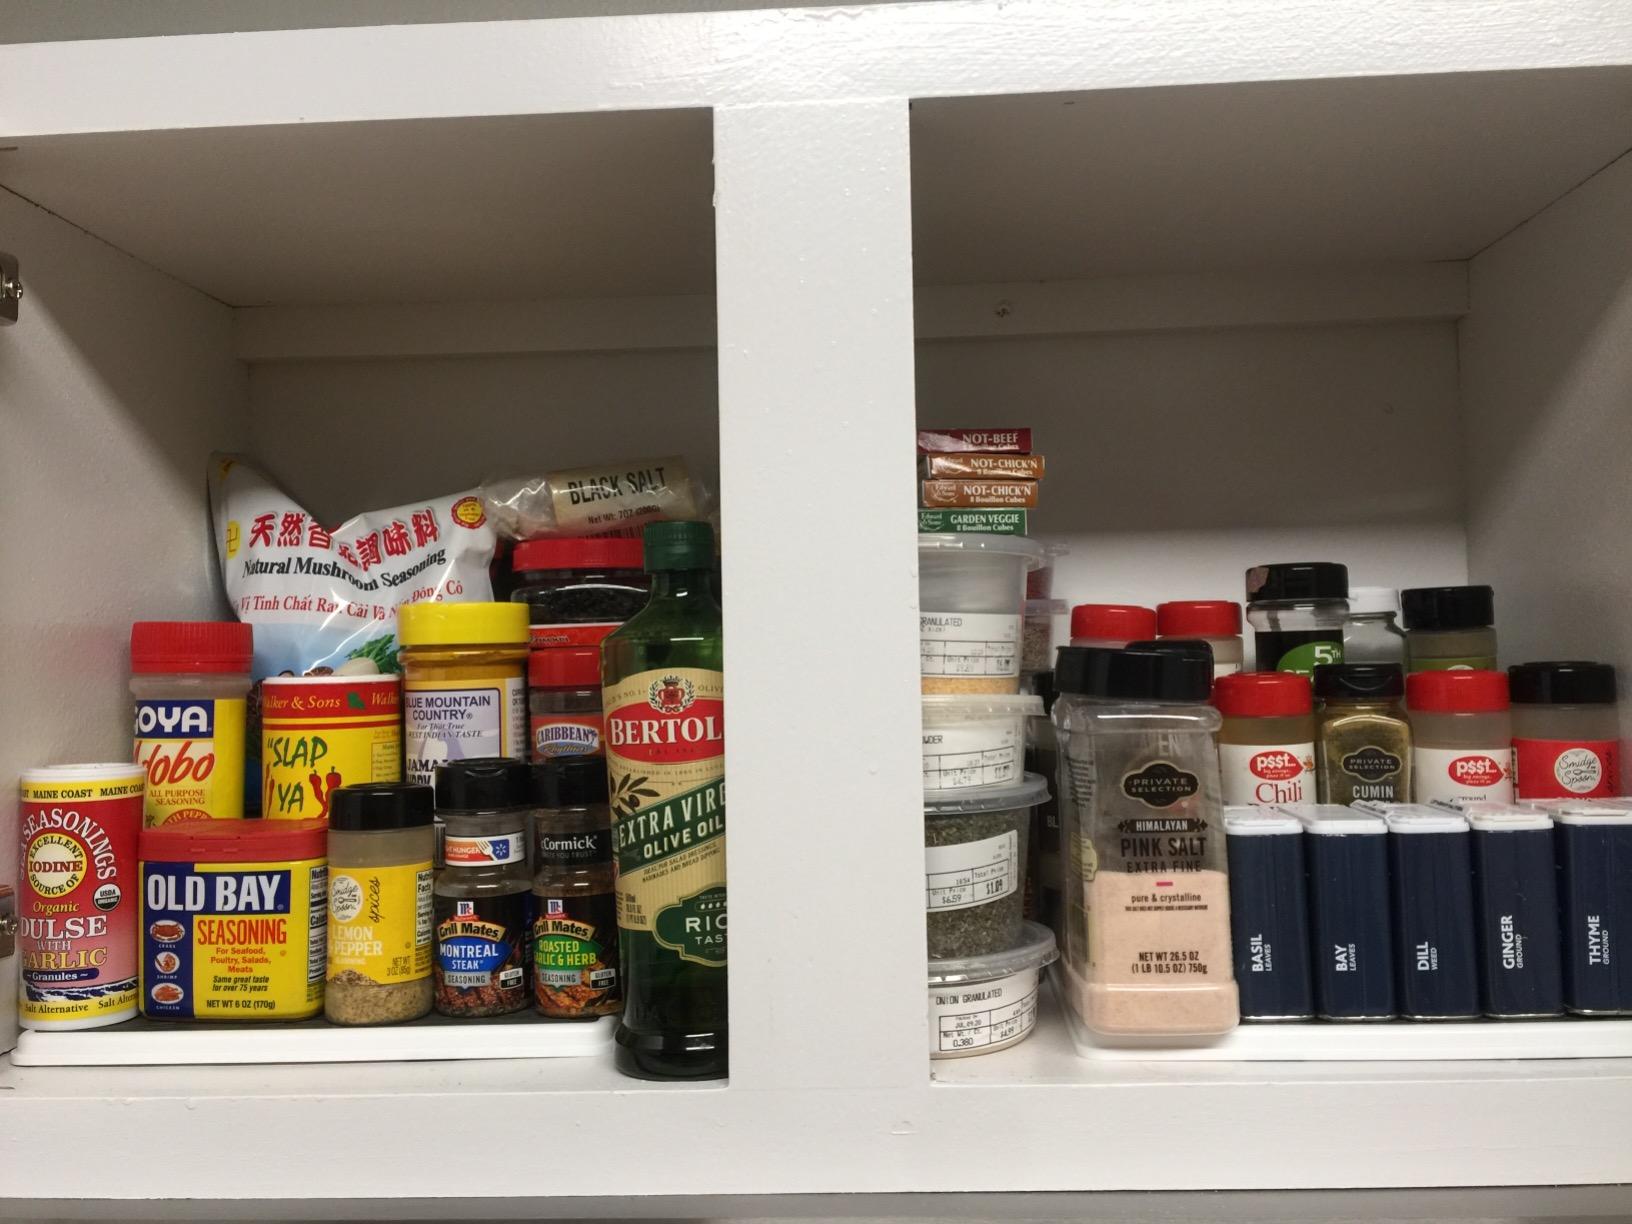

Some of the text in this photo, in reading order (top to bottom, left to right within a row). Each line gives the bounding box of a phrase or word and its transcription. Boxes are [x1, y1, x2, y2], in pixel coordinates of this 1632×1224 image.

[962, 432, 1019, 444] NOT-BEEF
[970, 458, 1038, 468] NOT-CHICK'N
[568, 467, 666, 504] BLACK SALT
[963, 485, 1031, 496] NOT-CHICK'N
[950, 514, 987, 524] GARDEN
[987, 514, 1020, 523] VEGGIE
[242, 549, 447, 592] Natural Mushroom Seasoning
[291, 695, 340, 710] & Sons
[425, 695, 491, 708] MOUNTAIN
[135, 705, 208, 733] OYA
[134, 740, 215, 785] dobo
[1133, 778, 1188, 786] PRIVATE
[32, 790, 58, 799] MAINE
[61, 789, 93, 799] COAST
[100, 786, 129, 797] MAINE
[165, 789, 206, 798] PURPOSE
[278, 781, 304, 814] YA
[1255, 780, 1302, 803] Chili
[1352, 785, 1394, 798] CUMIN
[155, 797, 206, 806] SEASONING
[619, 804, 674, 847] EXTRA
[1136, 820, 1188, 831] HIMALAYAN
[22, 808, 117, 880] SEASONINGS
[643, 815, 724, 859] OLIVE OIL
[29, 835, 83, 859] EXCELLENT
[1121, 837, 1207, 857] PINK SALT
[28, 860, 83, 873] IODINE
[1127, 860, 1201, 873] EXTRA FINE
[30, 873, 80, 895] SOURCE OF
[99, 889, 116, 898] USDA
[147, 874, 281, 911] OLD BAY
[1131, 892, 1201, 904] pure & crystalline
[32, 901, 80, 916] Organic
[19, 915, 107, 940] DULSE
[197, 918, 287, 945] SEASONING
[332, 926, 373, 940] LEMON
[440, 922, 499, 938] Grill Mates
[534, 920, 588, 937] Grill Mates
[36, 940, 72, 951] WITH
[538, 941, 579, 952] ROASTED
[1500, 915, 1515, 969] GINGER
[1588, 915, 1601, 965] THYME
[231, 947, 265, 956] Seafood,
[334, 941, 383, 956] PEPPER
[439, 944, 498, 958] MONTREAL
[1251, 934, 1264, 971] BASIL
[1515, 934, 1524, 968] GROUND
[1602, 930, 1610, 965] GROUND
[210, 957, 271, 966] Poultry, Salads,
[557, 953, 596, 966] & HERB
[1139, 951, 1199, 962] NET WT 26.5 OZ
[1264, 944, 1272, 971] LEAVES
[1335, 945, 1348, 971] BAY
[1349, 943, 1357, 971] LEAVES
[1416, 941, 1430, 971] DILL
[1430, 947, 1438, 970] WEED
[1131, 963, 1208, 974] (1 LB 10.5 OZ) 750g
[31, 972, 78, 981] Granules
[233, 976, 251, 985] great
[447, 975, 486, 985] SEASONING
[541, 972, 576, 983] SEASONING
[250, 985, 268, 993] years
[98, 998, 115, 1009] Salt
[935, 988, 1003, 1005] ONION GRANULATED
[38, 1003, 89, 1014] Alternative
[206, 1000, 276, 1010] NET WT 6 OZ (170g)
